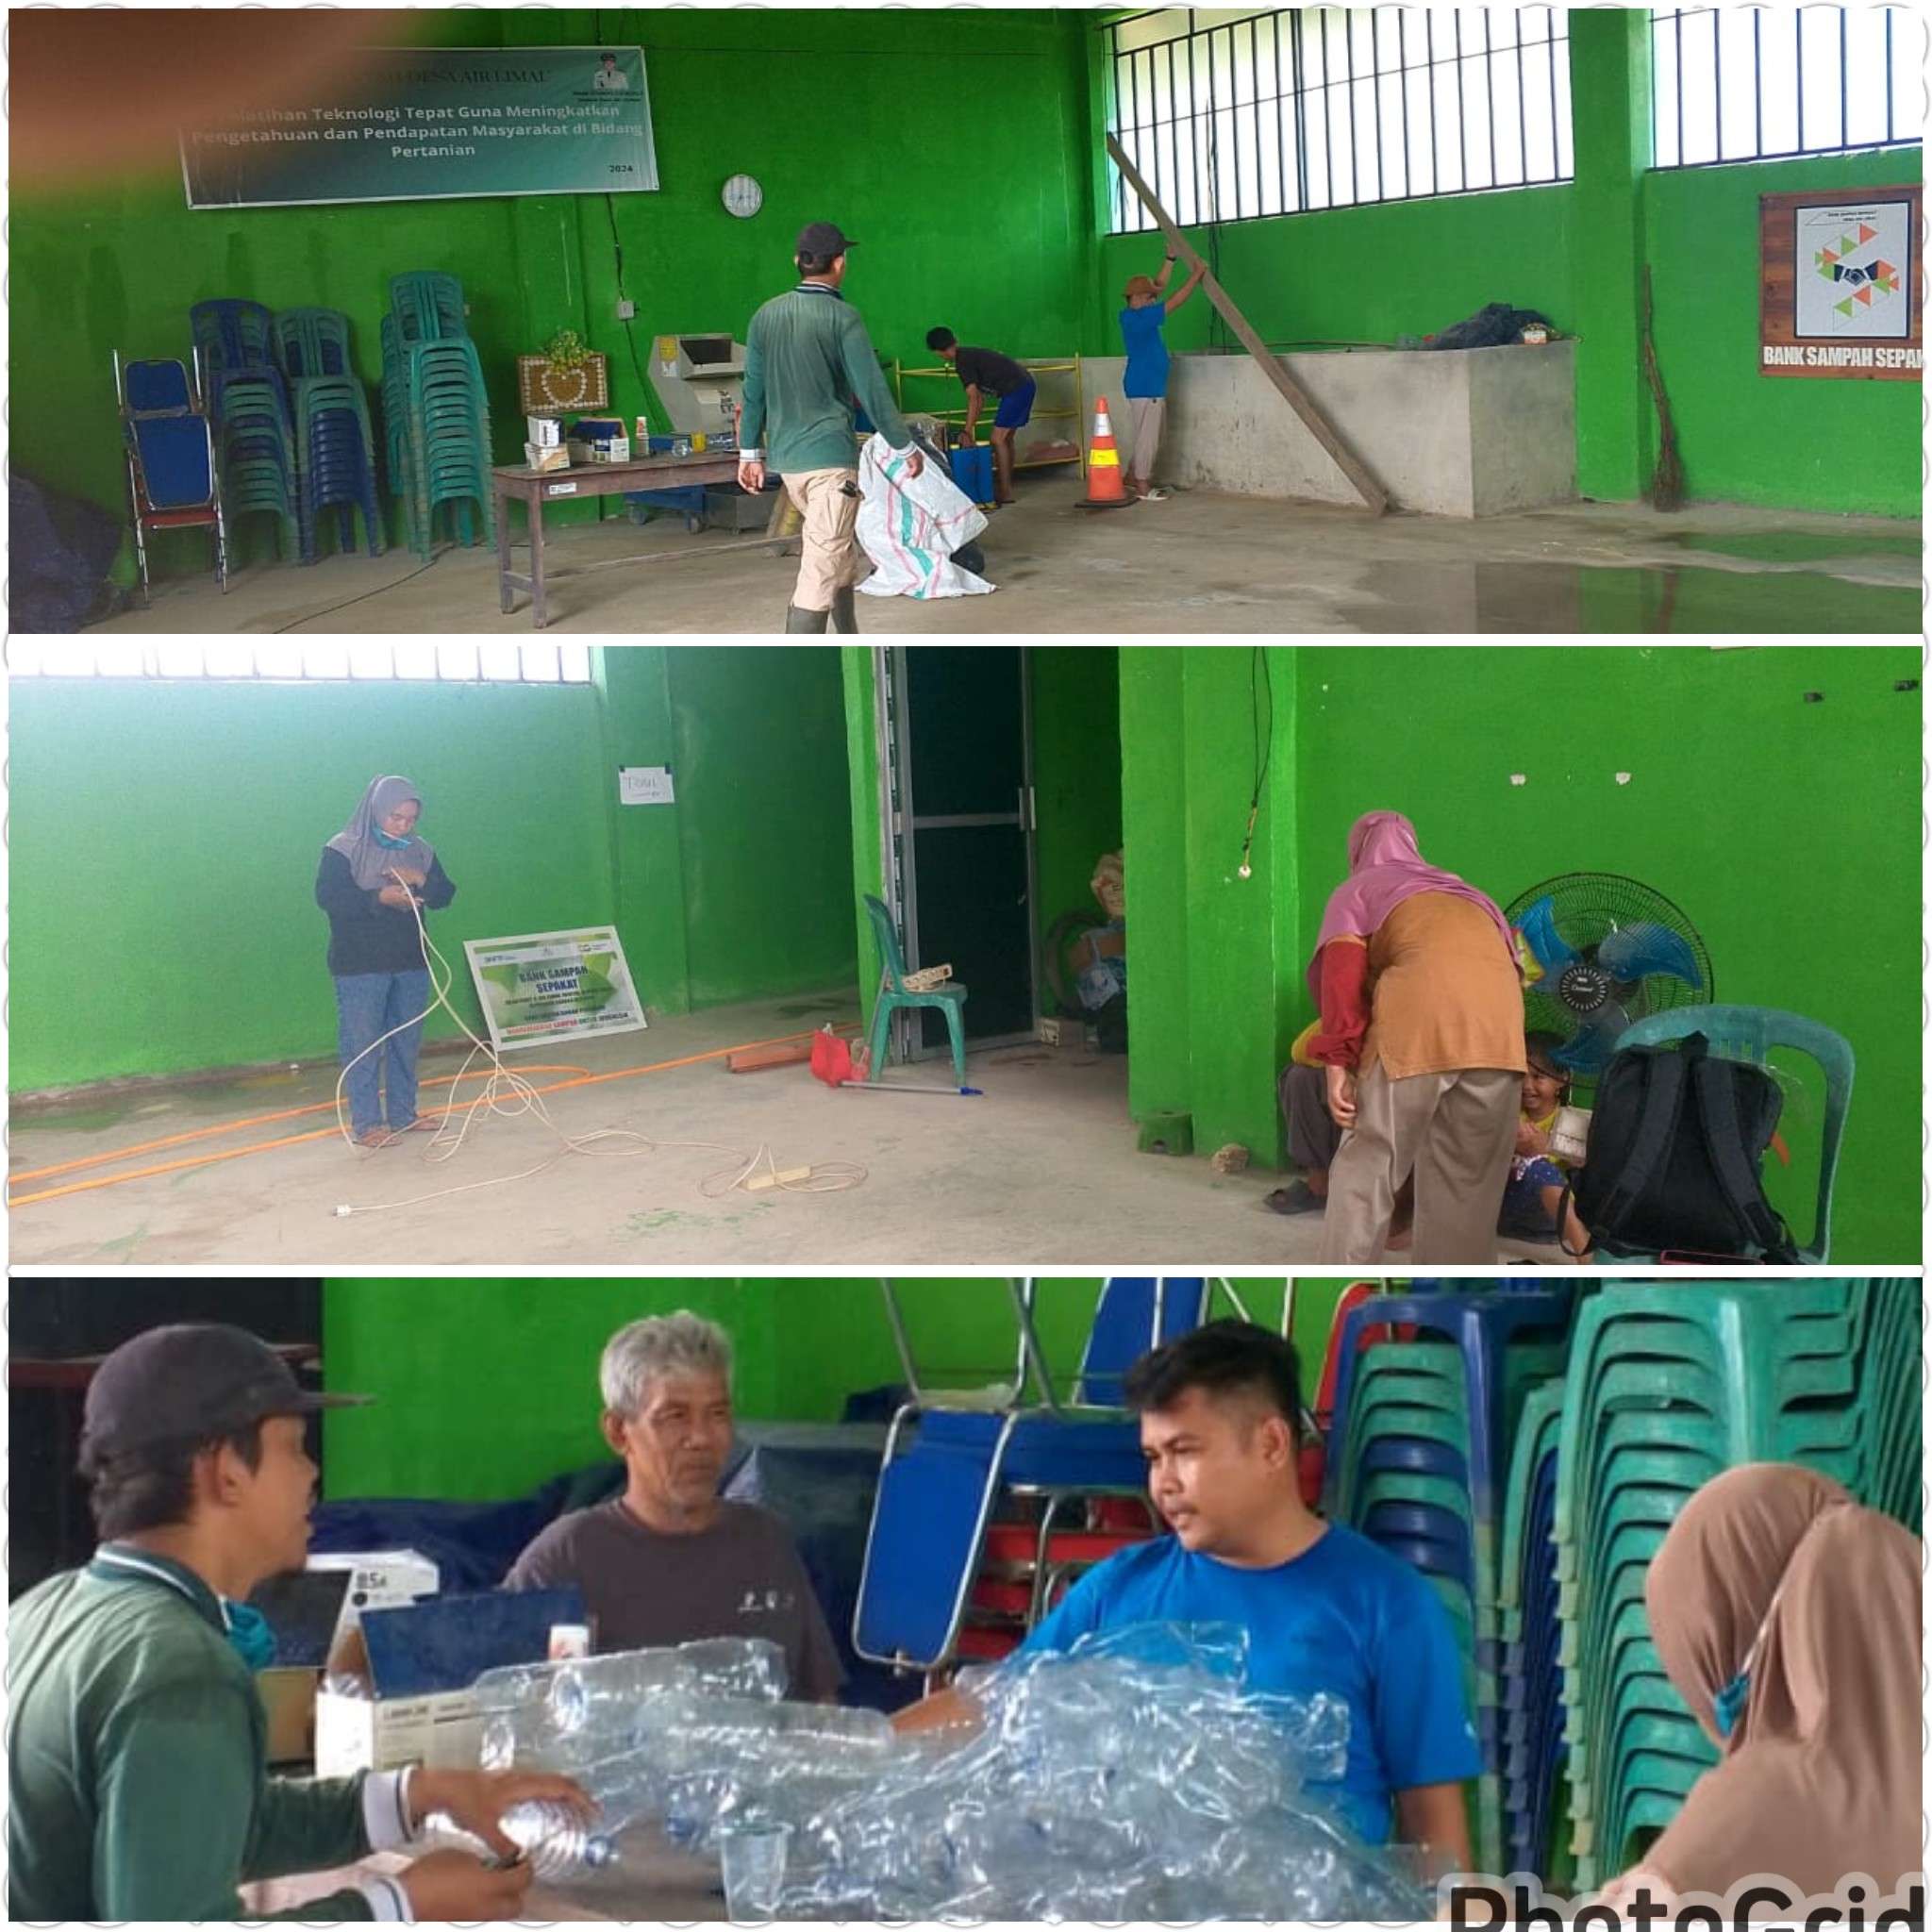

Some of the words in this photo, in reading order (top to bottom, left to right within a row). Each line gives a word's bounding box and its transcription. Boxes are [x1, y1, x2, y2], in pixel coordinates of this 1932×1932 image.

[312, 107, 401, 122] Teknologi
[405, 107, 453, 121] Tepat
[458, 106, 501, 118] Guna
[506, 104, 619, 120] Meningkatkan
[192, 128, 319, 145] Pengetahuan
[324, 126, 358, 140] dan
[363, 125, 468, 141] Pendapatan
[473, 123, 568, 139] Masyarakat
[573, 122, 587, 134] di
[591, 123, 643, 137] Bidang
[391, 143, 475, 158] Pertanian
[1763, 346, 1804, 365] BANK
[1806, 346, 1873, 367] SAMPAH
[520, 971, 547, 983] BANK
[536, 978, 579, 993] SEPAKAT
